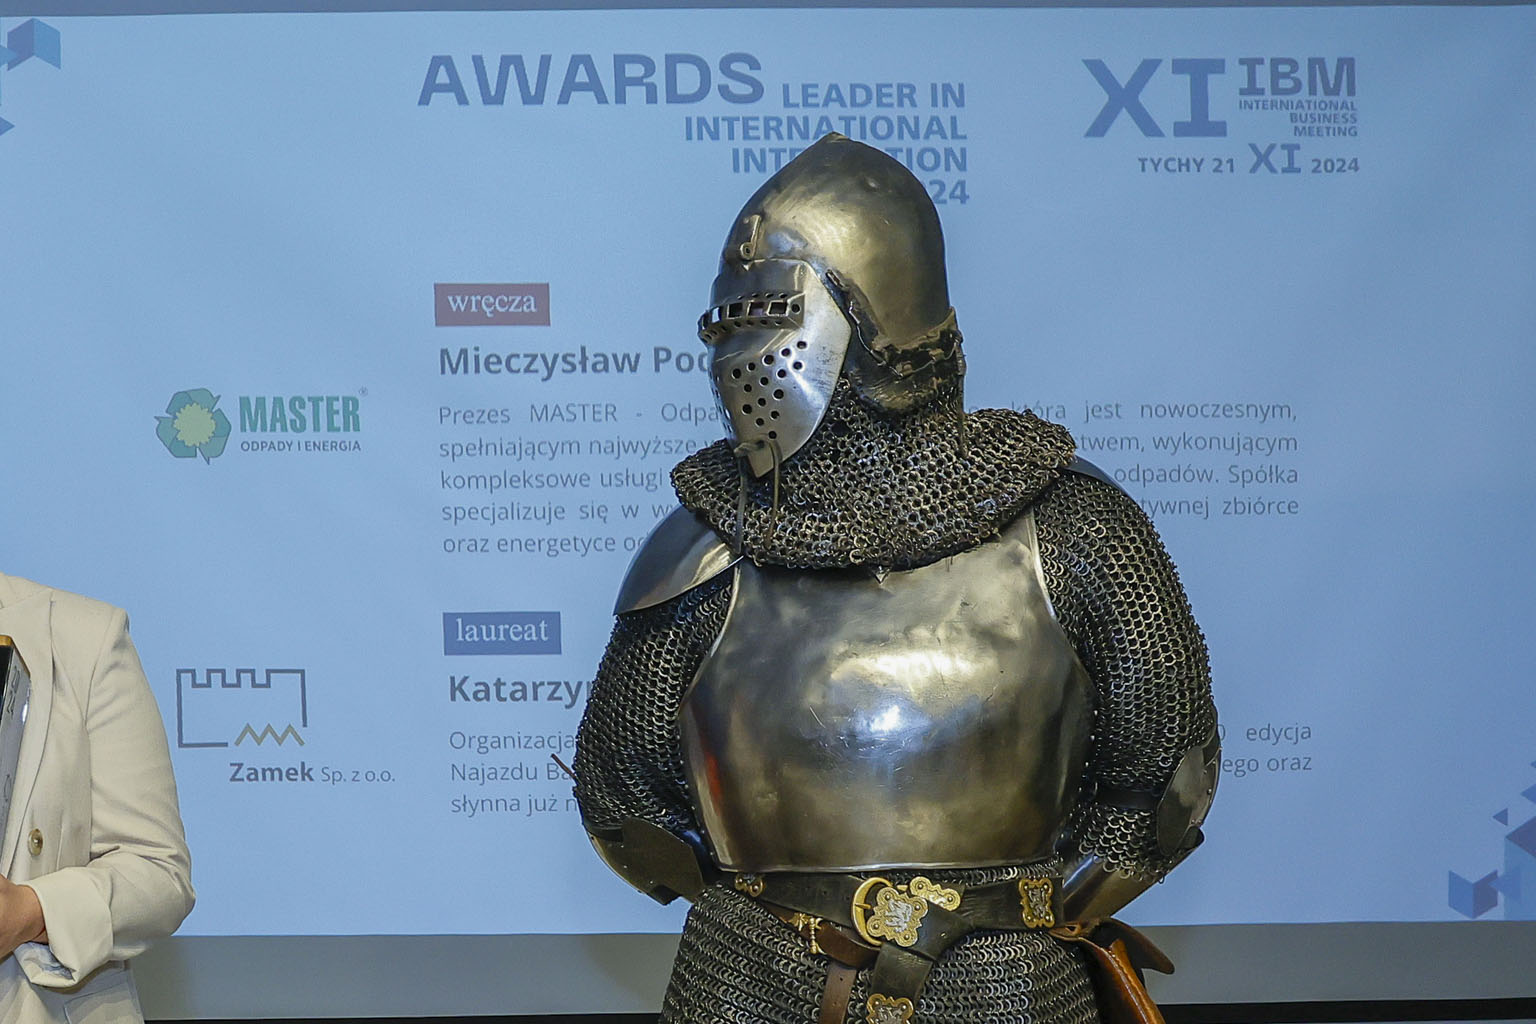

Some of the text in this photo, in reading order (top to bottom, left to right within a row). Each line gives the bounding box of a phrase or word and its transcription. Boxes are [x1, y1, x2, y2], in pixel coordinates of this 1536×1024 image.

[417, 52, 765, 106] AWARDS
[1238, 57, 1357, 97] IBM
[782, 82, 965, 108] LEADER IN
[1081, 58, 1227, 138] XI
[685, 115, 967, 141] INTERNATIONAL
[1289, 112, 1358, 124] BUSINESS
[1293, 125, 1359, 137] MEETING
[732, 146, 967, 173] INTTION
[1137, 143, 1360, 174] TYCHY 21 XI 2024
[925, 179, 969, 205] 24
[447, 293, 537, 317] wręcza
[439, 345, 641, 382] Mieczysław
[239, 395, 361, 433] MASTER
[439, 406, 511, 425] Prezes
[530, 403, 618, 424] MASTER
[1084, 401, 1122, 423] jest
[1140, 402, 1297, 425] nowoczesnym,
[240, 440, 293, 452] ODPADY
[305, 440, 362, 452] ENERGIA
[439, 436, 697, 463] spełniającym najwyższe
[1153, 431, 1298, 456] wykonującym
[441, 468, 663, 494] kompleksowe usługi
[1115, 463, 1299, 488] odpadów. Spółka
[442, 501, 566, 526] specjalizuje
[579, 501, 609, 524] się
[621, 504, 639, 519] w
[1222, 496, 1300, 517] zbiórce
[443, 537, 489, 553] oraz
[496, 535, 616, 558] energetyce
[456, 618, 549, 642] laureat
[449, 731, 576, 755] Organizacja
[1246, 722, 1312, 745] edycja
[229, 761, 396, 785] Zamek Sp. z o.o.
[450, 762, 538, 786] Najazdu
[1267, 756, 1313, 772] oraz
[451, 794, 520, 818] słynna
[526, 794, 559, 817] już
